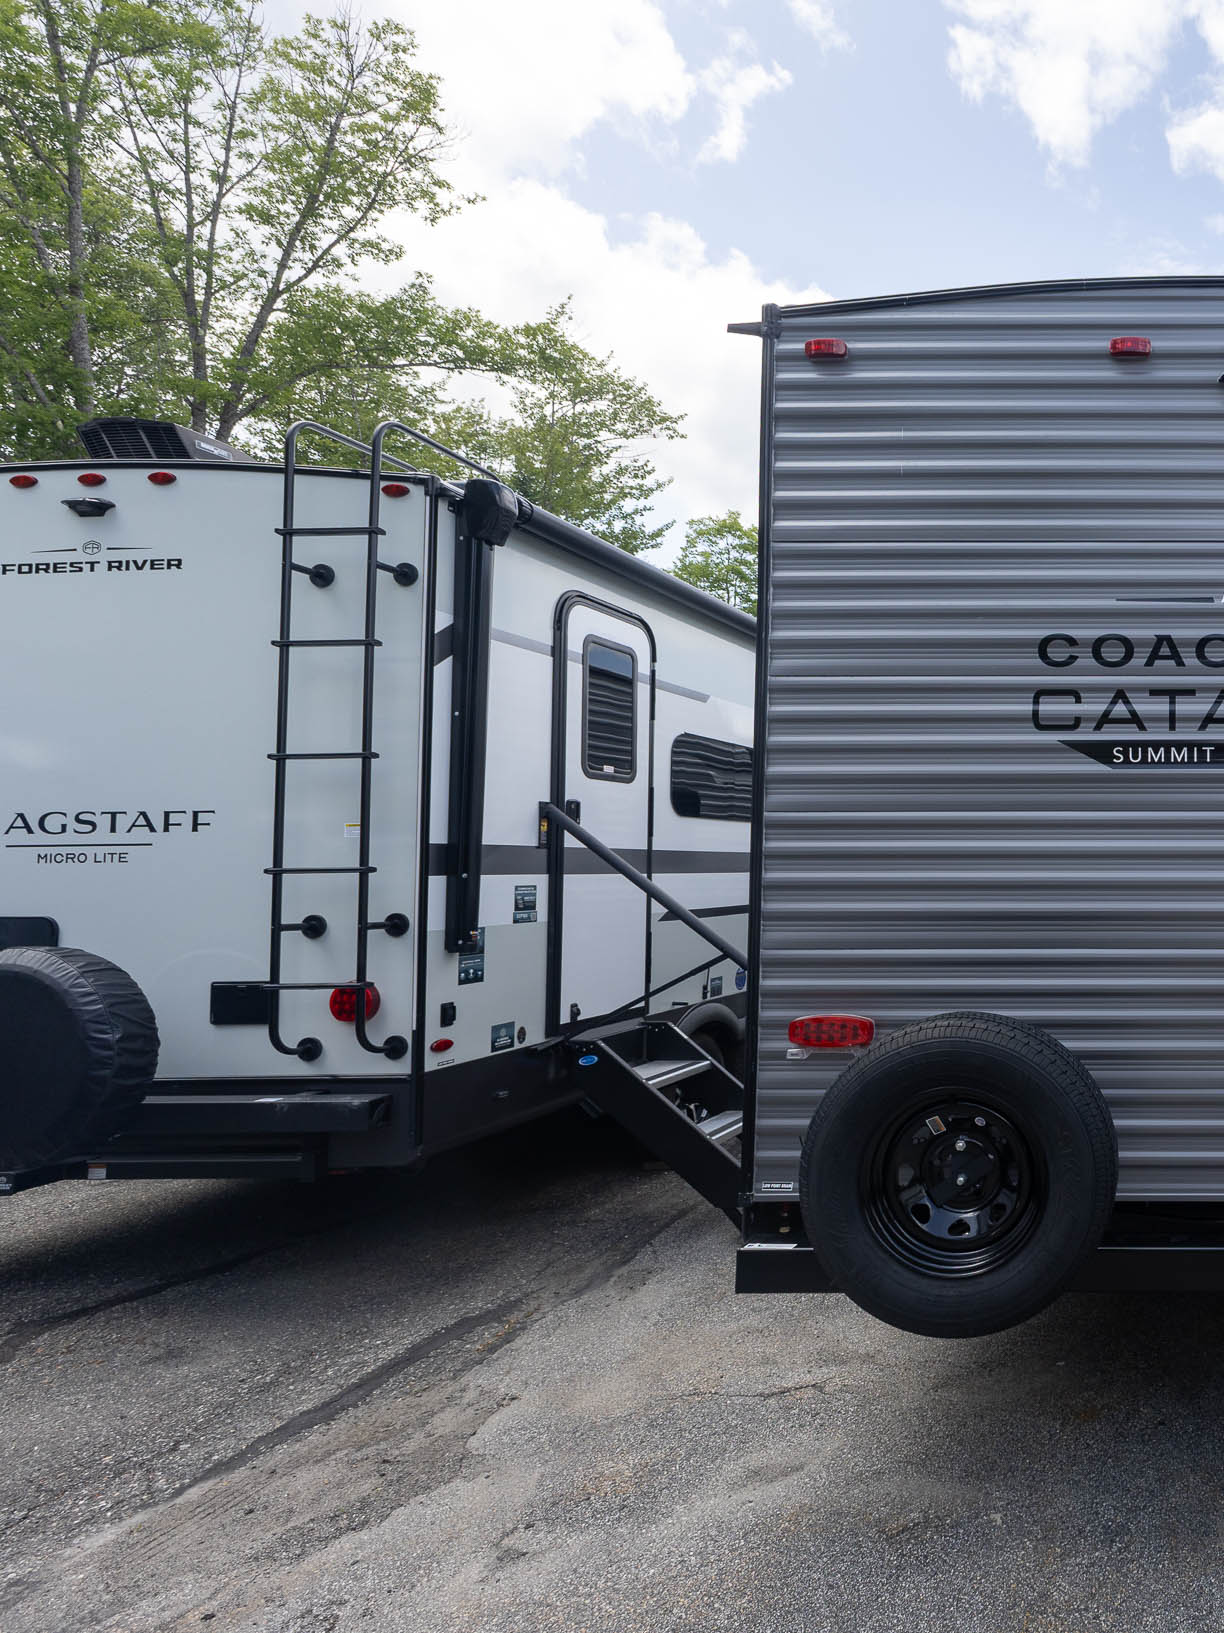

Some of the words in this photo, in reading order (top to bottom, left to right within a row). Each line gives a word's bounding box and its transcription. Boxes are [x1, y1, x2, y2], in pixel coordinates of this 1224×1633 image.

[1, 561, 100, 575] FOREST
[107, 558, 183, 571] RIVER
[1112, 746, 1215, 763] SUMMIT
[4, 810, 215, 835] AGSTAFF
[37, 853, 88, 864] MICRO
[94, 852, 128, 863] LITE
